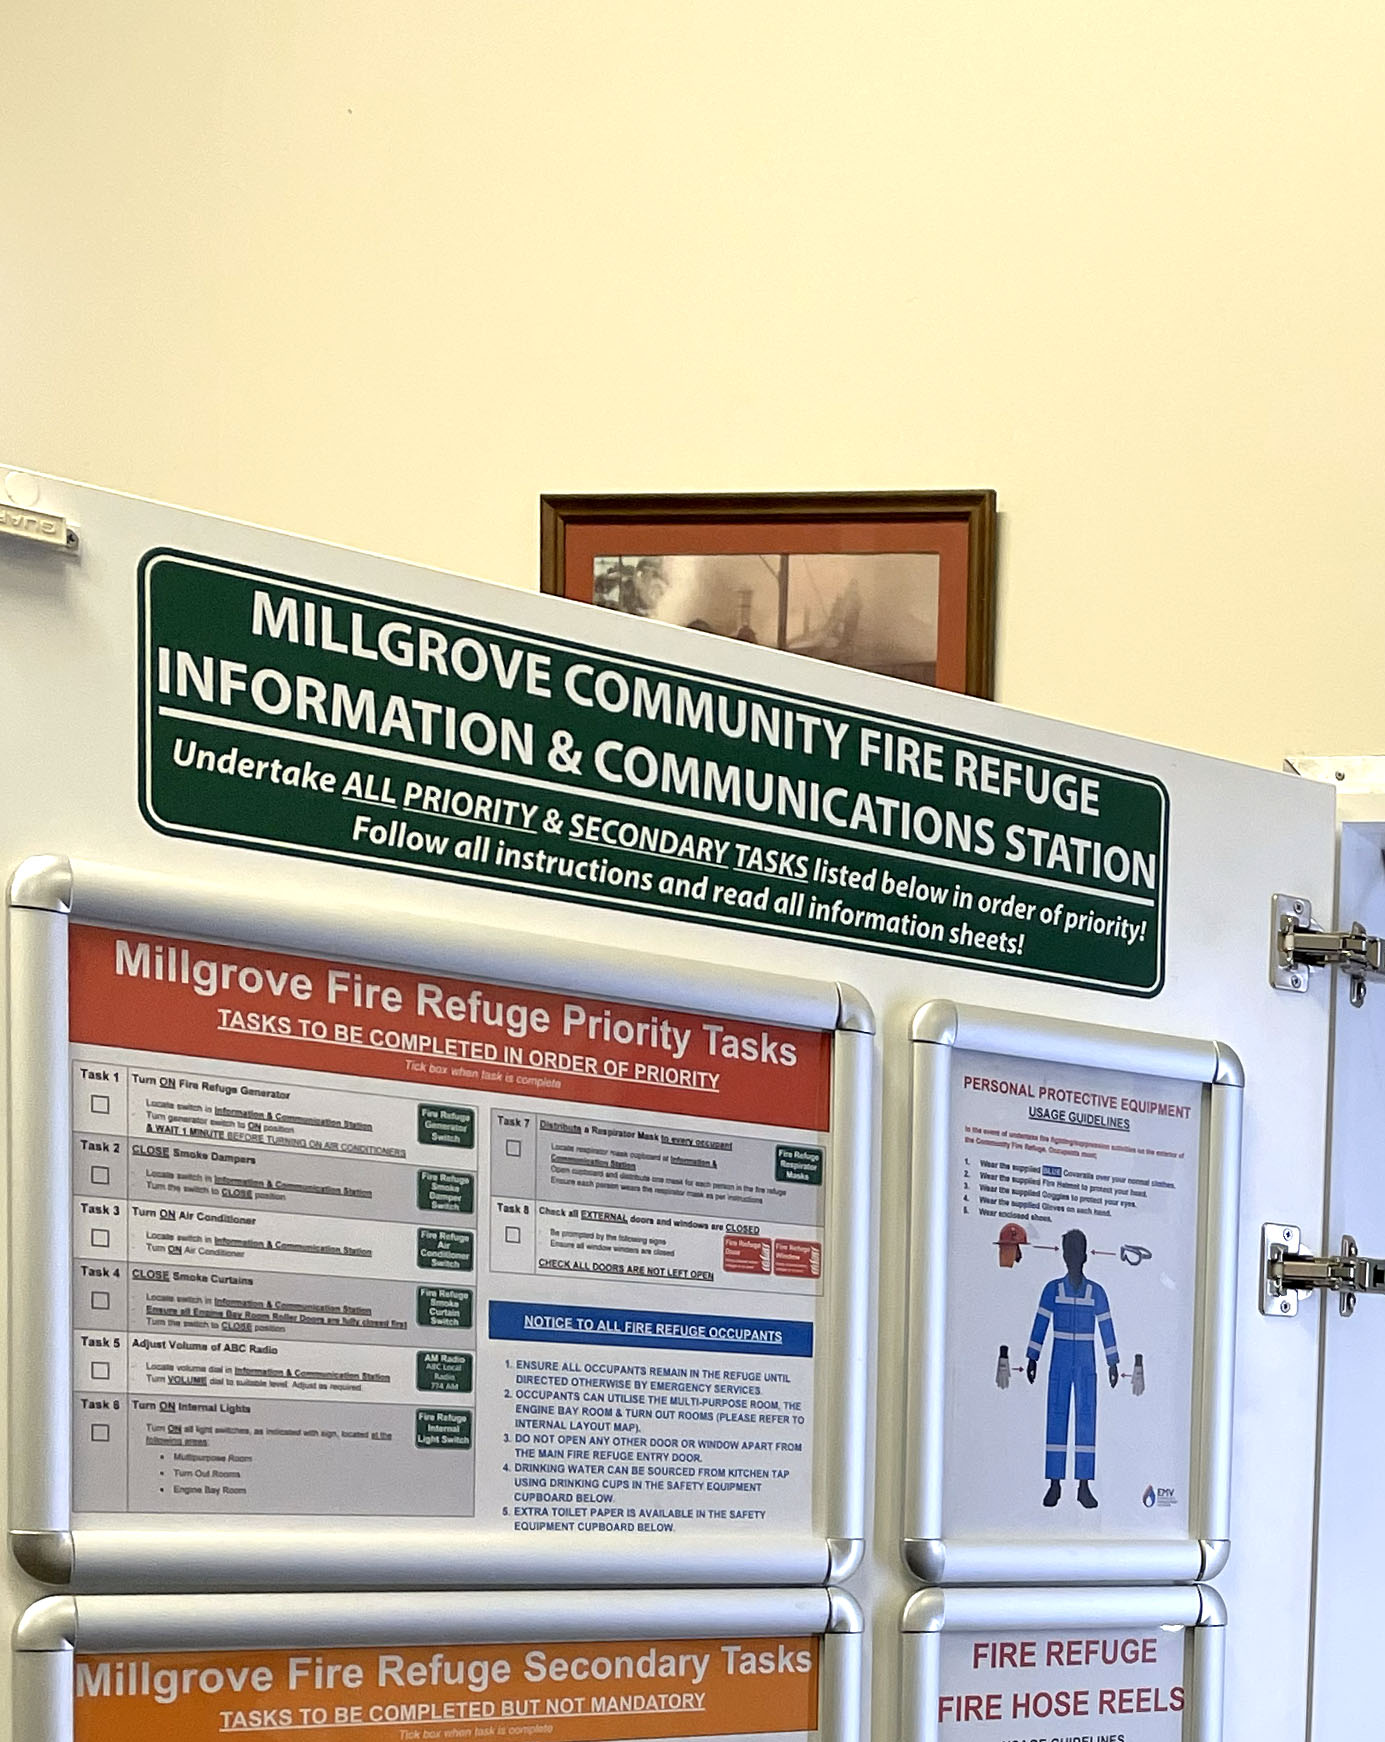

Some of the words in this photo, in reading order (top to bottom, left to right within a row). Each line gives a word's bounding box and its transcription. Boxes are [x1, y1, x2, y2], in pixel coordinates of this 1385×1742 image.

[252, 590, 551, 698] MILLGROVE
[564, 664, 849, 760] COMMUNITY
[860, 727, 943, 783] FIRE
[955, 743, 1101, 817] REFUGE
[158, 647, 532, 765] INFORMATION
[547, 730, 582, 775] &
[594, 740, 994, 856] COMMUNICATIONS
[1005, 824, 1155, 889] STATION
[173, 738, 336, 793] Undertake
[341, 771, 397, 809] ALL
[402, 782, 538, 834] PRIORITY
[542, 808, 563, 835] &
[568, 813, 730, 869] SECONDARY
[733, 843, 808, 884] TASKS
[813, 857, 877, 891] listed
[881, 870, 948, 904] below
[952, 884, 972, 909] in
[977, 894, 1036, 920] order
[1039, 903, 1063, 925] of
[1063, 910, 1146, 944] priority!
[352, 815, 449, 855] Follow
[454, 835, 490, 863] all
[495, 839, 652, 891] instructions
[658, 875, 708, 900] and
[712, 885, 769, 911] read
[773, 891, 804, 917] all
[808, 895, 943, 941] information
[948, 922, 1024, 955] sheets!
[116, 940, 312, 1000] Millgrove
[328, 970, 402, 1012] Fire
[417, 983, 549, 1038] Refuge
[563, 1000, 691, 1059] Priority
[702, 1013, 799, 1066] Tasks
[217, 1008, 291, 1038] TASKS
[299, 1019, 328, 1042] TO
[335, 1023, 363, 1046] BE
[370, 1028, 498, 1063] COMPLETED
[504, 1045, 523, 1066] IN
[529, 1048, 597, 1074] ORDER
[604, 1058, 628, 1078] OF
[635, 1062, 720, 1089] PRIORITY
[964, 1075, 1035, 1098] PERSONAL
[1038, 1086, 1117, 1109] PROTECTIVE
[1120, 1098, 1190, 1119] EQUIPMENT
[1029, 1106, 1065, 1120] USAGE
[1069, 1110, 1130, 1128] GUIDELINES
[524, 1315, 572, 1331] NOTICE
[577, 1318, 593, 1332] TO
[597, 1319, 621, 1333] ALL
[625, 1321, 651, 1335] FIRE
[656, 1323, 705, 1338] REFUGE
[709, 1326, 782, 1342] OCCUPANTS
[516, 1359, 558, 1371] ENSURE
[561, 1362, 581, 1372] ALL
[584, 1363, 646, 1376] OCCUPANTS
[649, 1367, 687, 1378] REMAIN
[689, 1369, 699, 1378] IN
[701, 1369, 720, 1380] THE
[722, 1370, 761, 1381] REFUGE
[763, 1373, 790, 1383] UNTIL
[76, 1661, 273, 1704] Millgrove
[289, 1657, 363, 1690] Fire
[378, 1653, 510, 1692] Refuge
[524, 1648, 709, 1684] Secondary
[720, 1644, 811, 1675] Tasks
[973, 1641, 1036, 1669] FIRE
[1046, 1638, 1156, 1666] REFUGE
[219, 1708, 292, 1728] TASKS
[300, 1707, 327, 1725] TO
[335, 1705, 363, 1724] BE
[369, 1700, 495, 1722] COMPLETED
[502, 1698, 540, 1718] BUT
[546, 1697, 585, 1716] NOT
[591, 1692, 705, 1714] MANDATORY
[938, 1694, 1002, 1723] FIRE
[1012, 1690, 1089, 1719] HOSE
[1098, 1686, 1185, 1715] REELS
